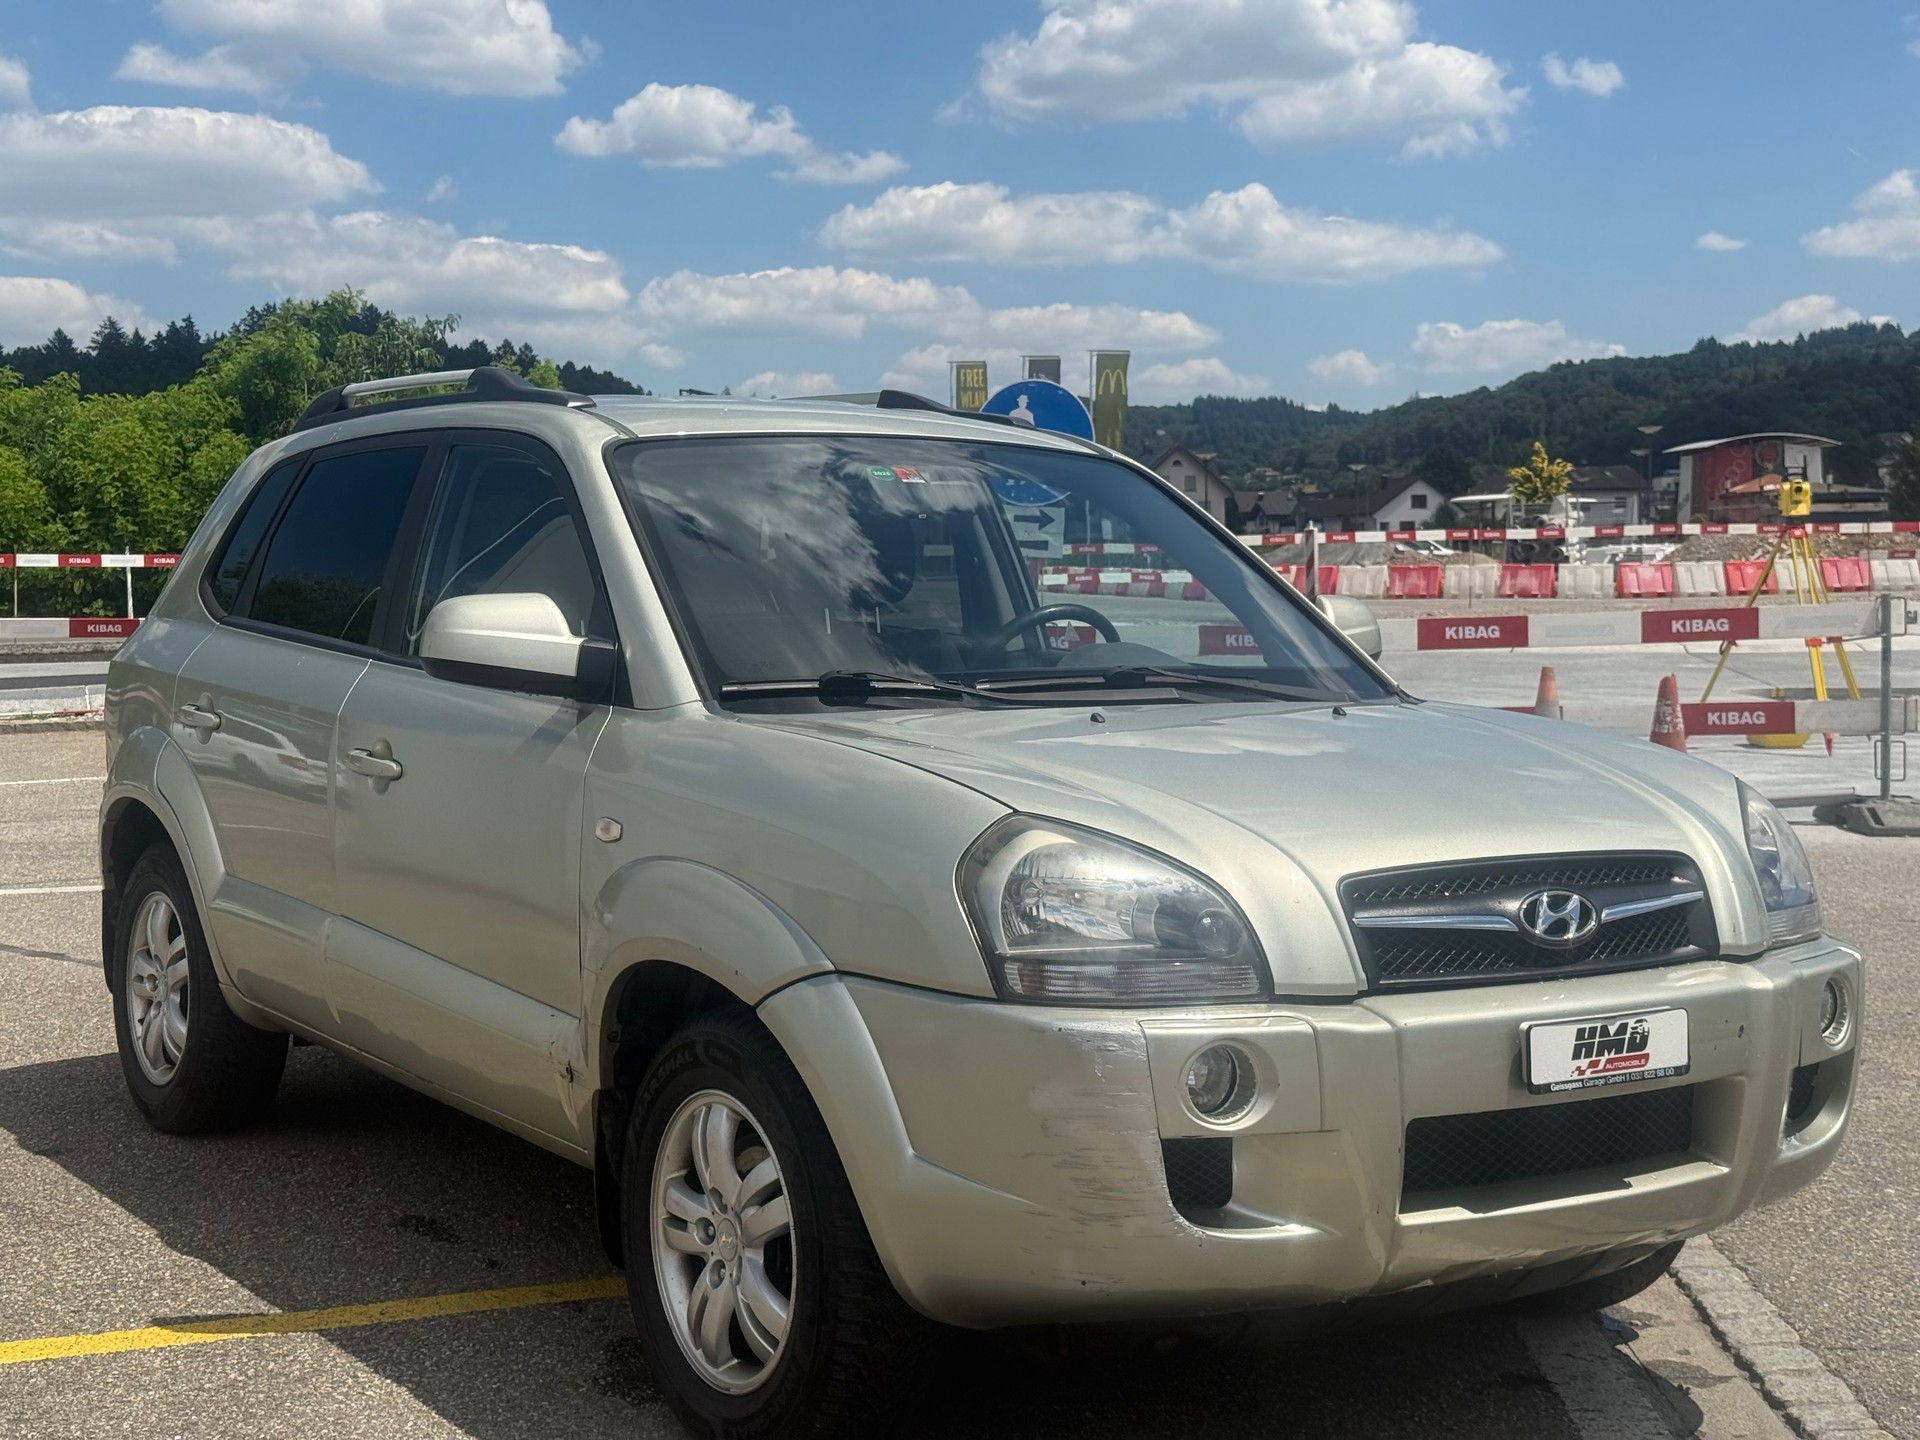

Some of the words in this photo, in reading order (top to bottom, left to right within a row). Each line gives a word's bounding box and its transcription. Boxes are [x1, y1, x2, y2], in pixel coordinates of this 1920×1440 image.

[960, 369, 984, 388] FREE
[960, 391, 986, 408] WLAN
[87, 624, 122, 632] KIBAG
[1445, 625, 1500, 640] KIBAG
[1671, 618, 1729, 632] KIBAG
[1225, 634, 1258, 647] KIB
[1707, 711, 1766, 726] KIBAG
[1605, 1059, 1646, 1069] AUTOMOBILE
[1550, 1081, 1583, 1092] Geissgass
[1583, 1077, 1606, 1087] Garage
[1606, 1075, 1626, 1084] GmbH
[1665, 1067, 1675, 1076] 00
